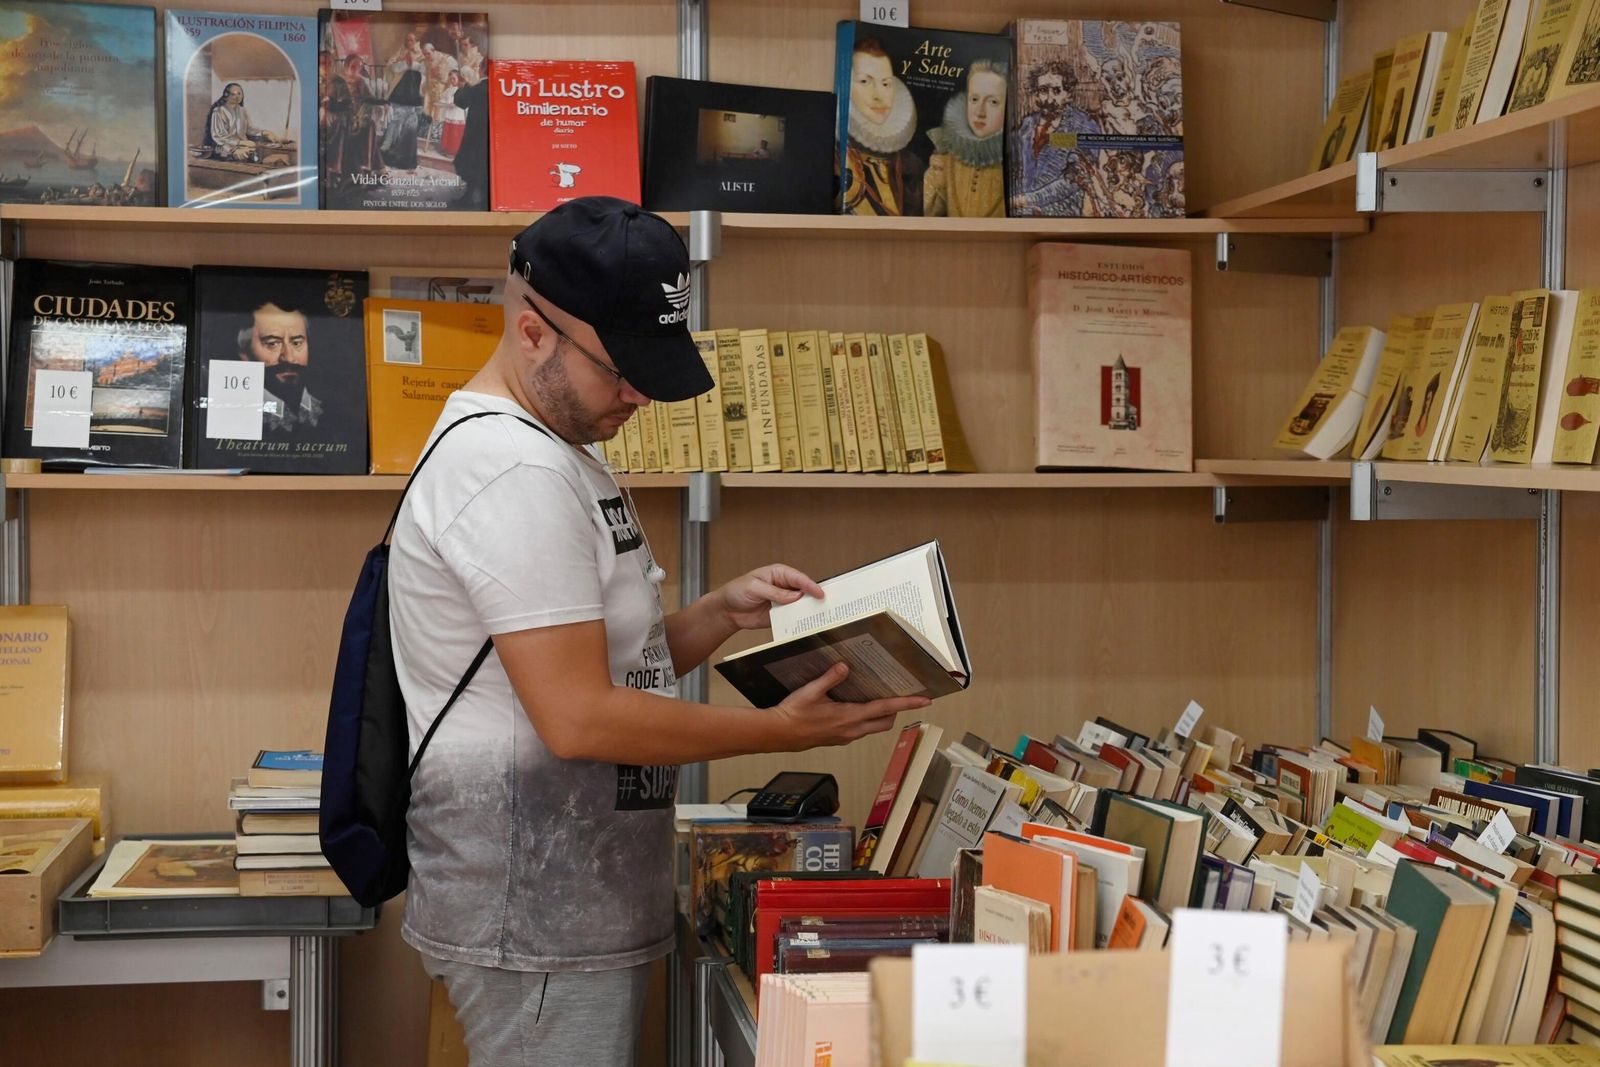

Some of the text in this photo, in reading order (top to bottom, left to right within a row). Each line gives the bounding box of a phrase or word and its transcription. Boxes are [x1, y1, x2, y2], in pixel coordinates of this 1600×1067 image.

[872, 7, 898, 21] 10 €
[178, 15, 306, 32] ILUSTRACIÓN FILIPINA
[183, 26, 201, 37] 859
[283, 32, 306, 43] 1860
[915, 40, 952, 58] Arte
[902, 58, 964, 78] y Saber
[499, 78, 625, 99] Un Lustro
[517, 100, 609, 116] Bimilenario
[540, 118, 587, 127] de humor
[351, 173, 377, 186] Vidal
[720, 181, 756, 192] ALISTE
[363, 200, 387, 208] PINTOR
[389, 200, 408, 208] ENTRE
[1058, 270, 1184, 286] HISTÓRICO-ARTÍSTICOS
[33, 294, 176, 322] CIUDADES
[33, 315, 50, 326] DE
[55, 317, 121, 330] CASTILLA
[124, 321, 134, 331] Y
[659, 309, 688, 324] adid
[224, 376, 251, 390] 10 €
[402, 375, 435, 388] Rejería
[51, 385, 78, 400] 10 €
[755, 344, 773, 435] INFUNDADAS
[216, 438, 348, 452] Theatrum sacrum
[0, 632, 49, 642] NARIO
[626, 669, 661, 690] CODE
[952, 788, 988, 820] Cómo hemos
[967, 821, 981, 836] esto
[1207, 941, 1252, 978] 3 €
[947, 975, 993, 1010] 3 €
